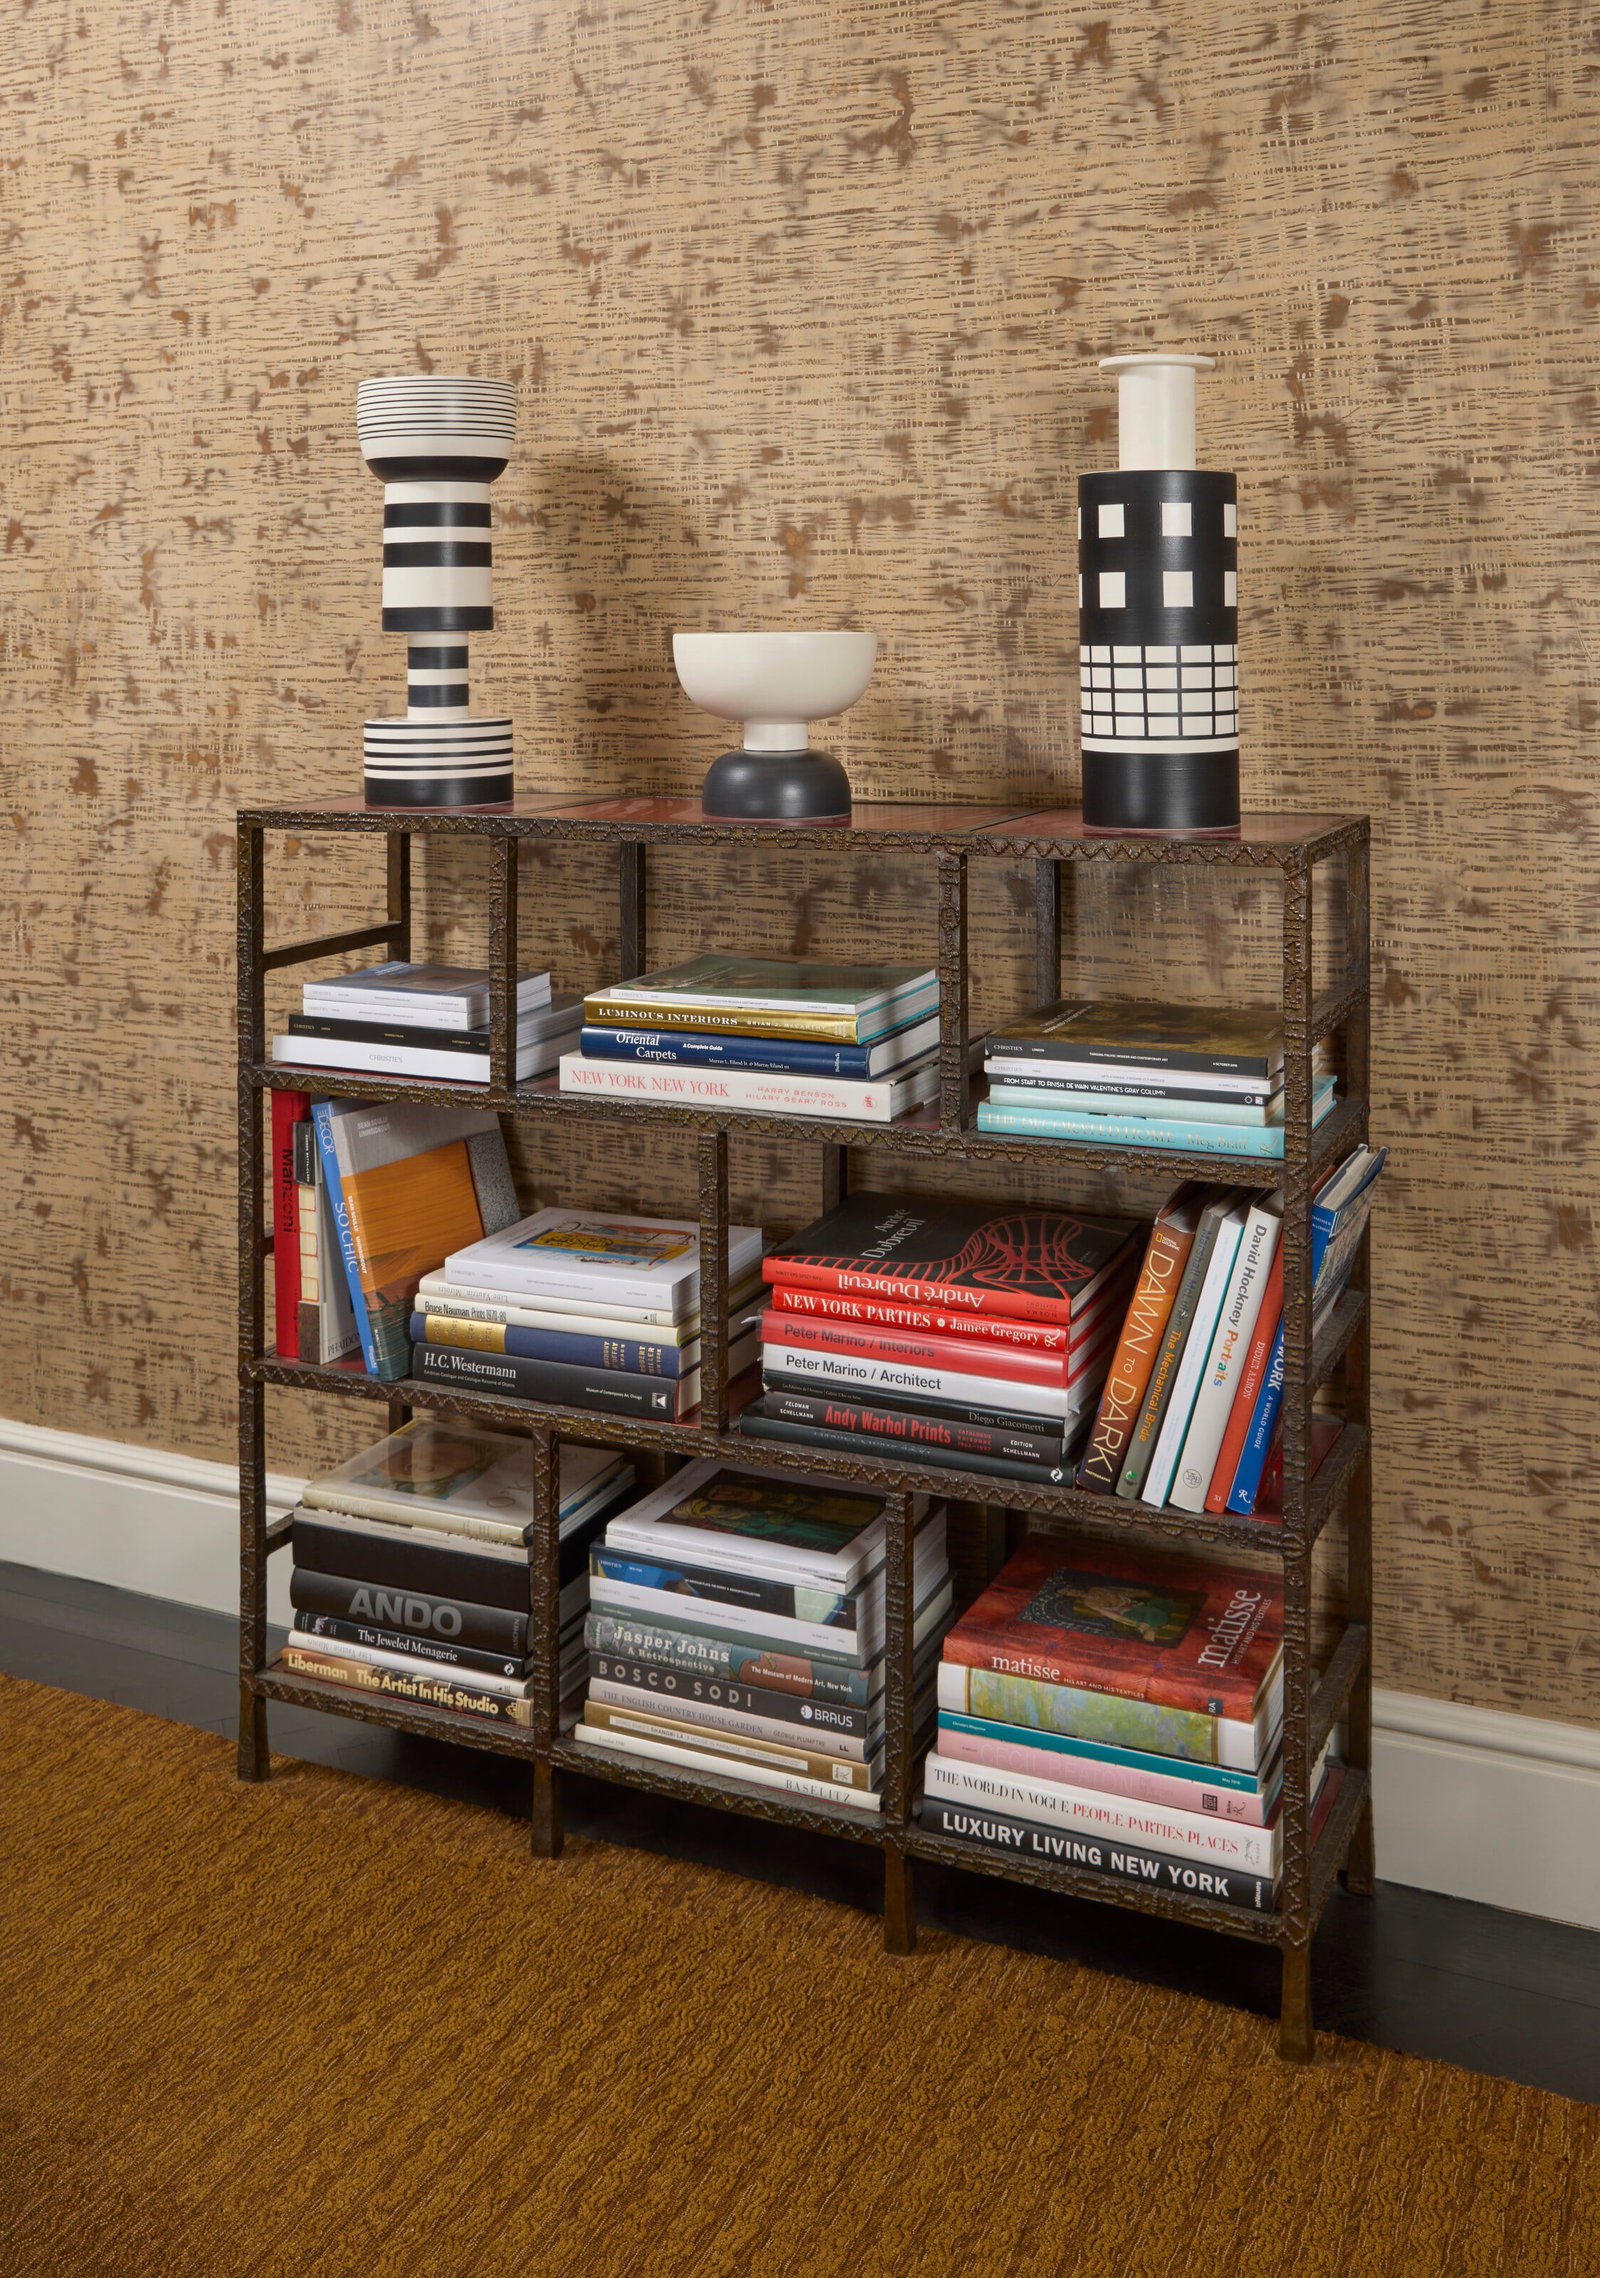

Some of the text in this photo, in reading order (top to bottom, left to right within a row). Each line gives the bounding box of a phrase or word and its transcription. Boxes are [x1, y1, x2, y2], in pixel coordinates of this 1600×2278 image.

[598, 1008, 738, 1026] LUMINOUS INTERIORS
[616, 1032, 660, 1046] Oriental
[687, 1043, 709, 1051] Complete
[636, 1046, 677, 1061] Carpets
[770, 1062, 784, 1070] Eiland
[571, 1070, 729, 1097] NEW YORK NEW YORK
[794, 1090, 835, 1100] BENSON
[1020, 1078, 1036, 1086] START
[1090, 1084, 1124, 1093] VALENTINE'S
[1124, 1086, 1140, 1094] GRAY
[1140, 1088, 1166, 1096] COLUMN
[745, 1094, 847, 1108] HILARY GEARY ROSS
[318, 1112, 335, 1155] DECOR
[986, 1112, 1016, 1128] THE
[1021, 1116, 1120, 1138] DECORATED
[1124, 1128, 1175, 1145] HOME
[1187, 1133, 1215, 1150] Meg
[281, 1148, 297, 1233] Manzoni
[874, 1209, 911, 1232] André
[335, 1202, 360, 1273] SO CHIC
[860, 1218, 926, 1258] Dubreuil
[1190, 1229, 1212, 1277] Marshall
[838, 1274, 920, 1300] Dubreuil
[923, 1284, 985, 1308] André
[424, 1300, 442, 1312] Bruce
[443, 1304, 470, 1318] Nauman
[472, 1307, 485, 1319] Prints
[783, 1292, 1040, 1346] NEW YORK PARTIES Jamee Gregory
[1214, 1223, 1268, 1388] David Hockney Portraits
[784, 1324, 936, 1358] Peter Marino / Interiors
[1166, 1330, 1182, 1350] The
[424, 1352, 517, 1380] H.C. Westermann
[786, 1354, 942, 1391] Peter Marino / Architect
[1088, 1249, 1176, 1473] DAWN TO DARK
[1242, 1341, 1266, 1400] DIDIER AARON
[1149, 1352, 1176, 1412] Mechanical
[780, 1408, 814, 1419] SCHELLMANN
[785, 1400, 810, 1410] FELDMAN
[1260, 1402, 1272, 1426] WORLD
[825, 1404, 858, 1432] Andy
[861, 1410, 907, 1436] Warhol
[910, 1418, 952, 1445] Prints
[968, 1412, 1045, 1432] Diego Giacometti
[1138, 1412, 1157, 1441] Bride
[1010, 1439, 1033, 1449] EDITION
[1254, 1427, 1266, 1449] GUIDE
[1002, 1447, 1040, 1459] SCHELLMANN
[349, 1588, 463, 1637] ANDO
[1198, 1590, 1262, 1668] matisse
[1232, 1598, 1273, 1665] HIS ART AND HIS TEXTILES
[358, 1629, 376, 1646] The
[376, 1632, 410, 1651] Jeweled
[410, 1640, 458, 1663] Menagerie
[614, 1626, 730, 1663] Jasper Johns
[627, 1647, 715, 1674] A Retrospective
[288, 1654, 499, 1716] Liberman The Artist In His Studio
[598, 1660, 752, 1708] BOSCO SODI
[751, 1666, 762, 1674] The
[762, 1668, 785, 1679] Museum
[792, 1674, 814, 1685] Modern
[814, 1679, 826, 1688] Art,
[826, 1681, 840, 1690] New
[840, 1684, 853, 1694] York
[991, 1656, 1060, 1682] matisse
[1088, 1682, 1102, 1690] AND
[1116, 1688, 1145, 1699] TEXTILES
[602, 1690, 764, 1734] THE ENGLISH COUNTRY HOUSE GARDEN
[814, 1708, 854, 1728] BRAUS
[1208, 1702, 1217, 1714] RA
[772, 1730, 825, 1747] GEORGE PLUMPTRE
[786, 1779, 852, 1804] BASELITZ
[934, 1768, 960, 1787] THE
[962, 1775, 1009, 1800] WORLD
[1011, 1786, 1024, 1802] IN
[1028, 1790, 1070, 1815] VOGUE
[1187, 1830, 1239, 1856] PLACES
[942, 1811, 1230, 1898] LUXURY LIVING NEW YORK
